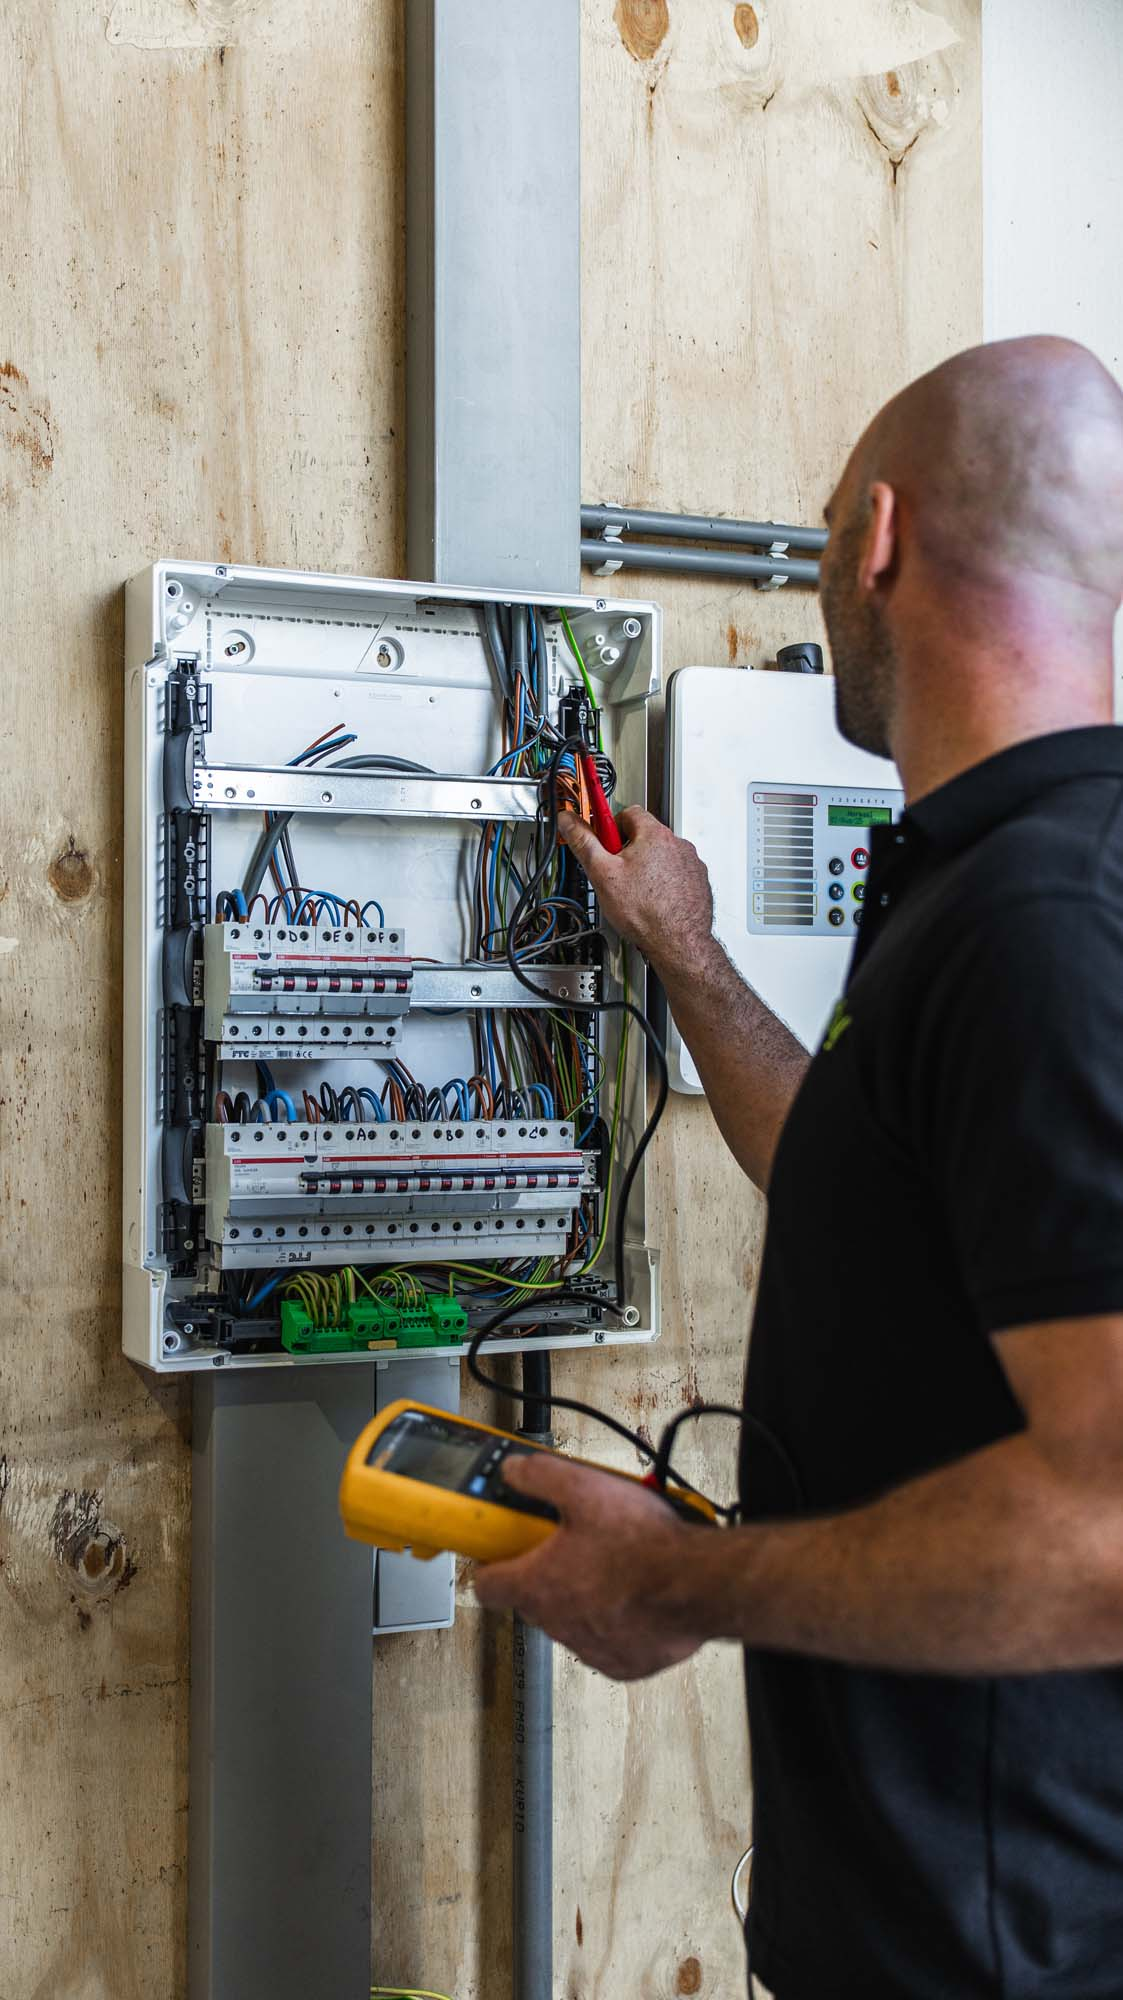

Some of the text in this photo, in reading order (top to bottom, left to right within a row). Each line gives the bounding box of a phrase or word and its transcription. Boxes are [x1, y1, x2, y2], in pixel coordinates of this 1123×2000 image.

[288, 930, 298, 942] D
[333, 930, 342, 942] E
[378, 932, 385, 943] F
[356, 1128, 367, 1141] A
[445, 1130, 454, 1141] B
[528, 1127, 539, 1139] C
